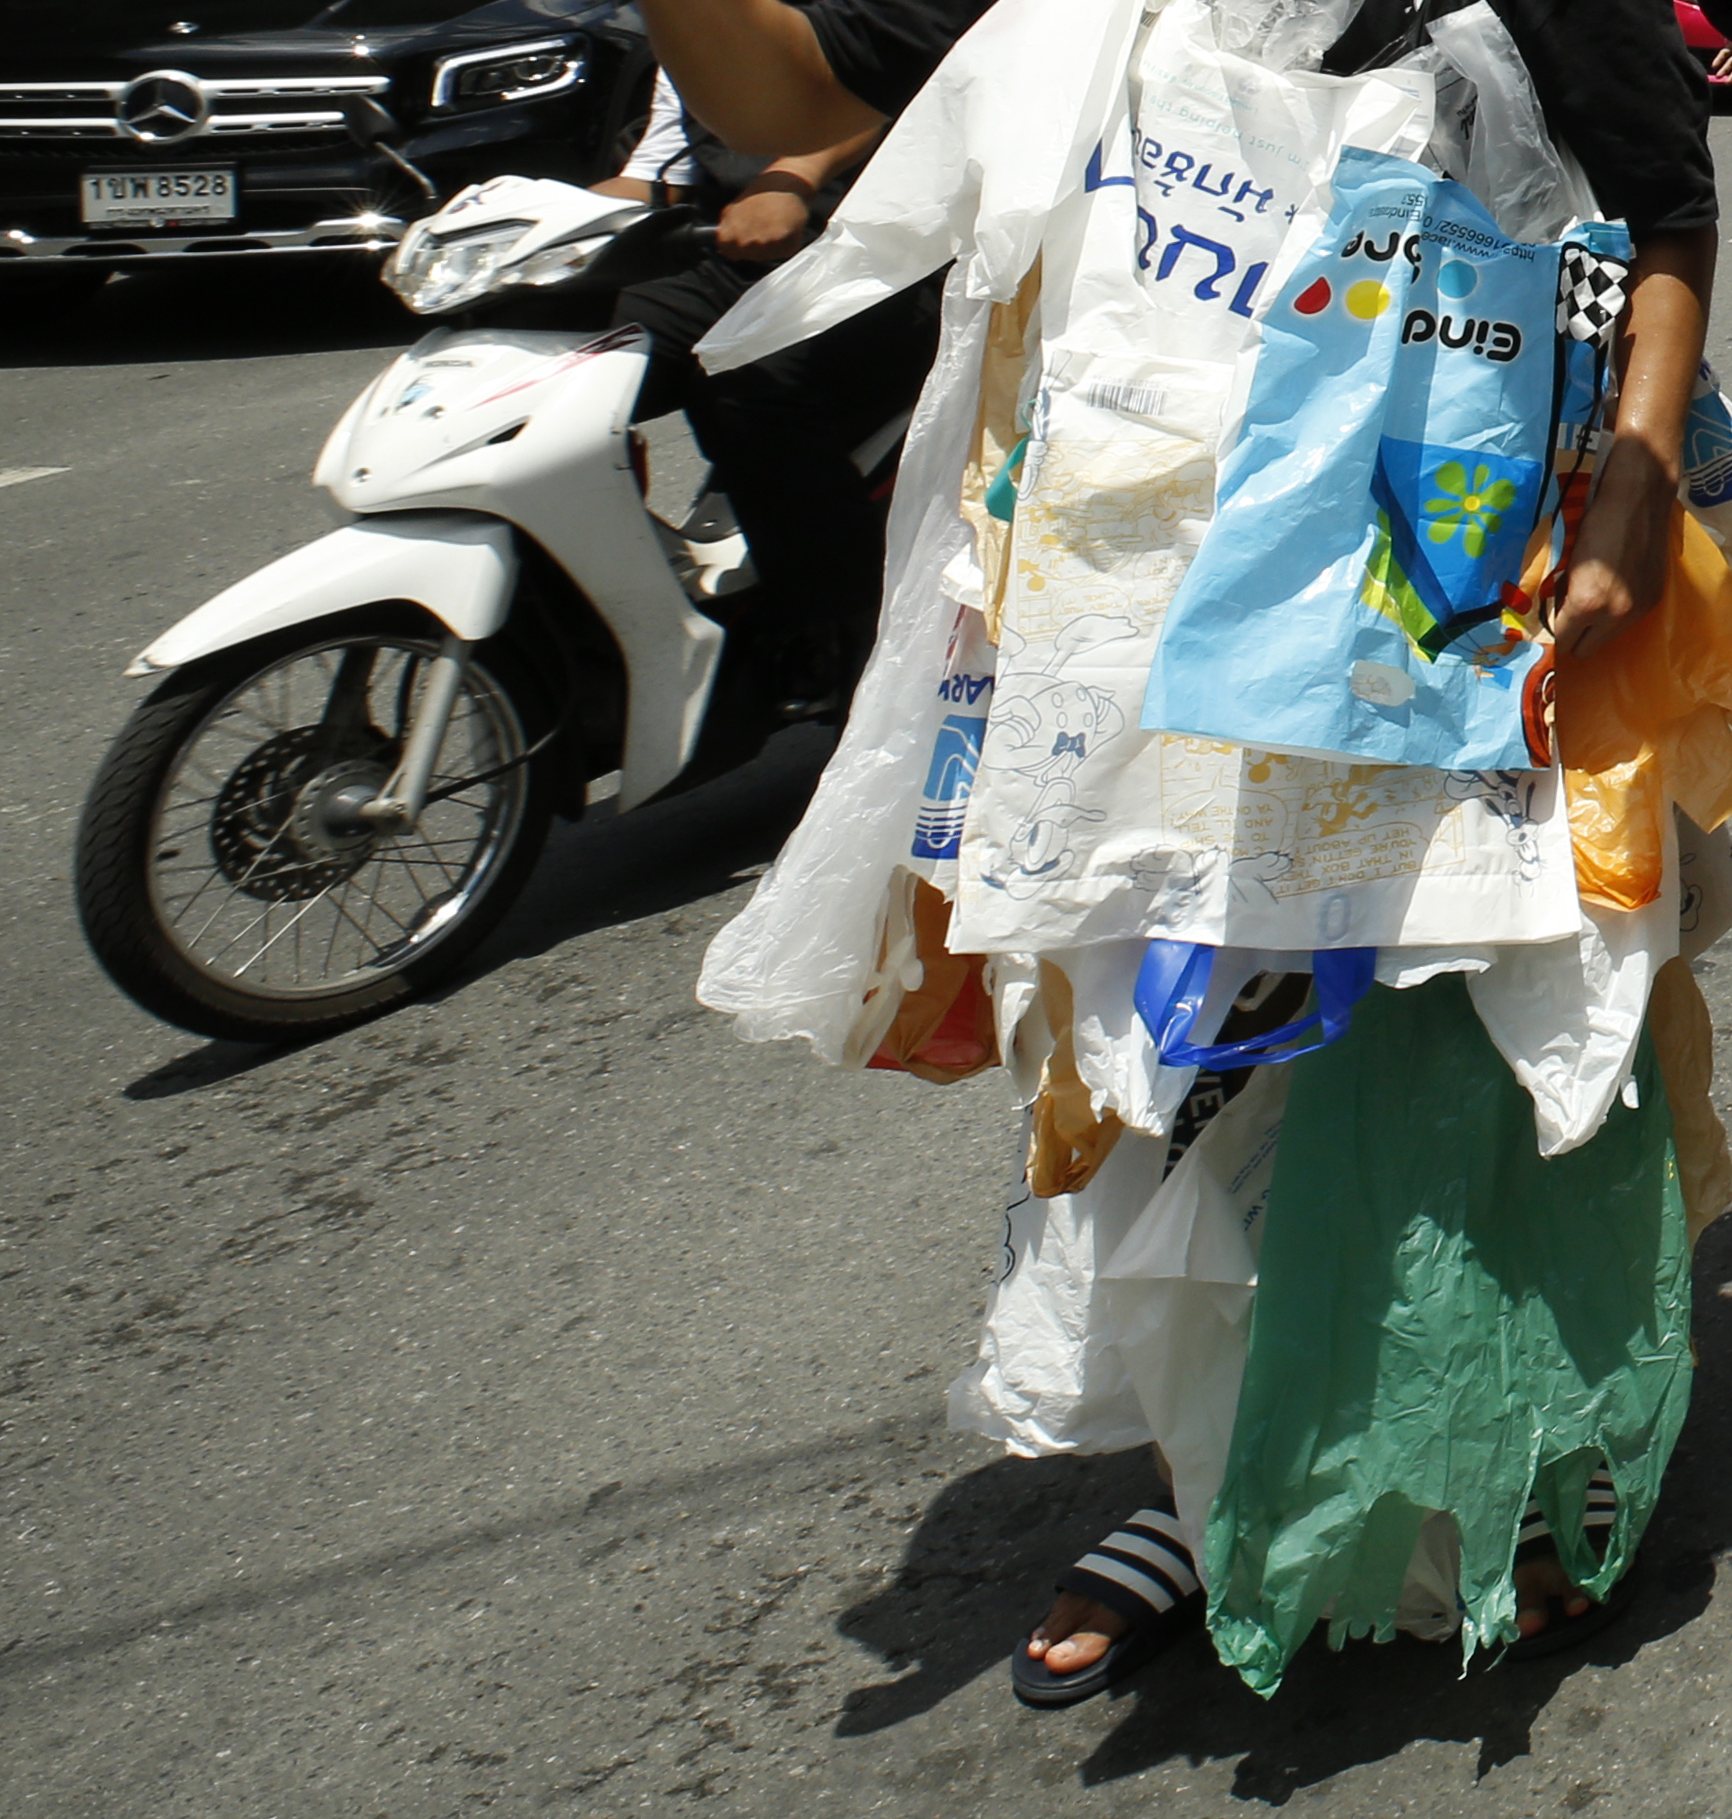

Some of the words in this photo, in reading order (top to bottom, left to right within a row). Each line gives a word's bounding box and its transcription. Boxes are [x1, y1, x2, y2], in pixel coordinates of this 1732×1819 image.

[156, 174, 228, 198] 8528
[1401, 309, 1522, 363] Eind
[1251, 832, 1271, 842] TO
[1357, 833, 1378, 845] UP
[1383, 827, 1411, 841] HET
[1357, 855, 1390, 869] THAT
[1398, 850, 1414, 862] IN
[1322, 860, 1351, 874] BOX
[1392, 860, 1418, 874] BUT
